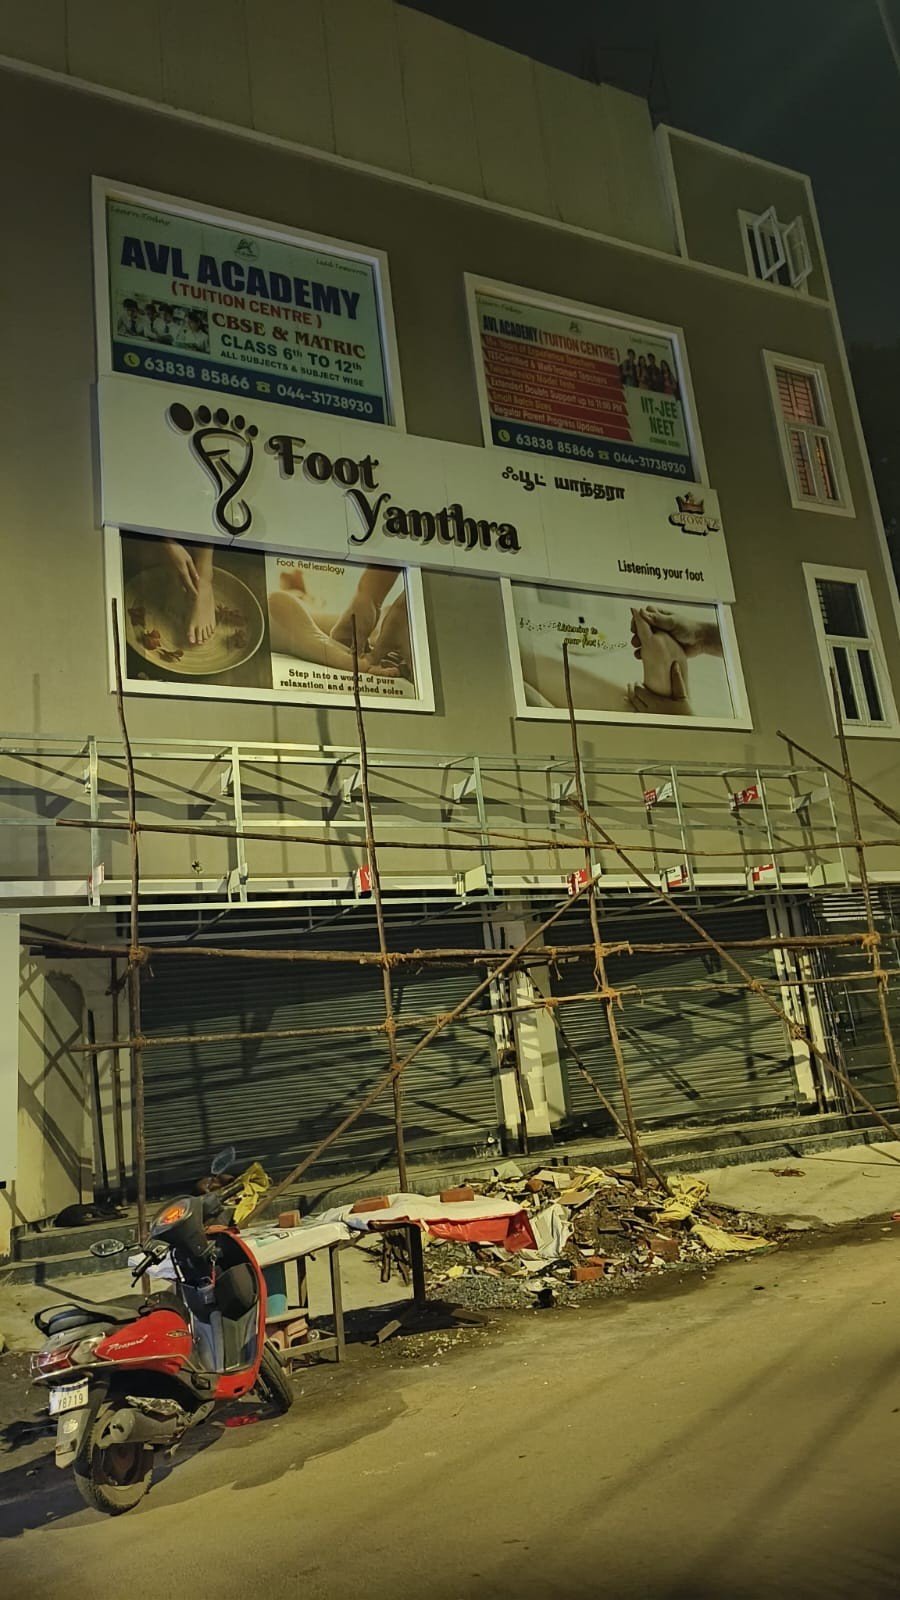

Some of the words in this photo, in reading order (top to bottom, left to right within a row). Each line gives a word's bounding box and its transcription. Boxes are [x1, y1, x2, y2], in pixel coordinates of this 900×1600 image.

[121, 235, 187, 278] AVL
[197, 254, 360, 319] ACADEMY
[212, 311, 265, 336] CBSE
[272, 326, 288, 342] &
[295, 330, 365, 359] MATRIC
[483, 315, 497, 331] AVL
[498, 319, 538, 341] ACADEMY
[220, 349, 237, 359] ALL
[240, 353, 288, 370] SUBJECTS
[290, 364, 297, 372] &
[300, 366, 339, 381] SUBJECT
[342, 375, 363, 387] WISE
[221, 333, 277, 356] CLASS
[283, 347, 302, 362] 6th
[307, 352, 329, 368] TO
[335, 358, 362, 375] 12th
[144, 357, 194, 378] 63838
[201, 368, 249, 390] 85866
[276, 383, 372, 414] 044-31738930
[490, 377, 523, 391] Extended
[550, 389, 576, 404] Support
[577, 397, 587, 407] up
[587, 397, 594, 406] to
[611, 402, 623, 412] PM
[494, 404, 521, 418] Regular
[522, 410, 545, 422] Parent
[546, 415, 575, 430] Progress
[576, 421, 604, 436] Updates
[640, 396, 677, 418] IIT-JEE
[649, 417, 675, 437] NEET
[265, 434, 380, 492] Foot
[516, 435, 553, 450] 63838
[557, 443, 593, 458] 85866
[613, 452, 686, 474] 044-31738930
[346, 488, 522, 552] Yanthra
[276, 558, 295, 568] Foot
[297, 560, 346, 576] Reflexology
[617, 559, 661, 580] Listening
[663, 568, 684, 581] your
[685, 567, 704, 582] foot
[280, 680, 324, 690] relaxation
[327, 684, 344, 692] and
[382, 687, 404, 697] soles
[289, 669, 310, 679] Step
[312, 671, 331, 681] into
[340, 674, 363, 683] wod
[366, 675, 374, 683] of
[376, 678, 396, 686] pure
